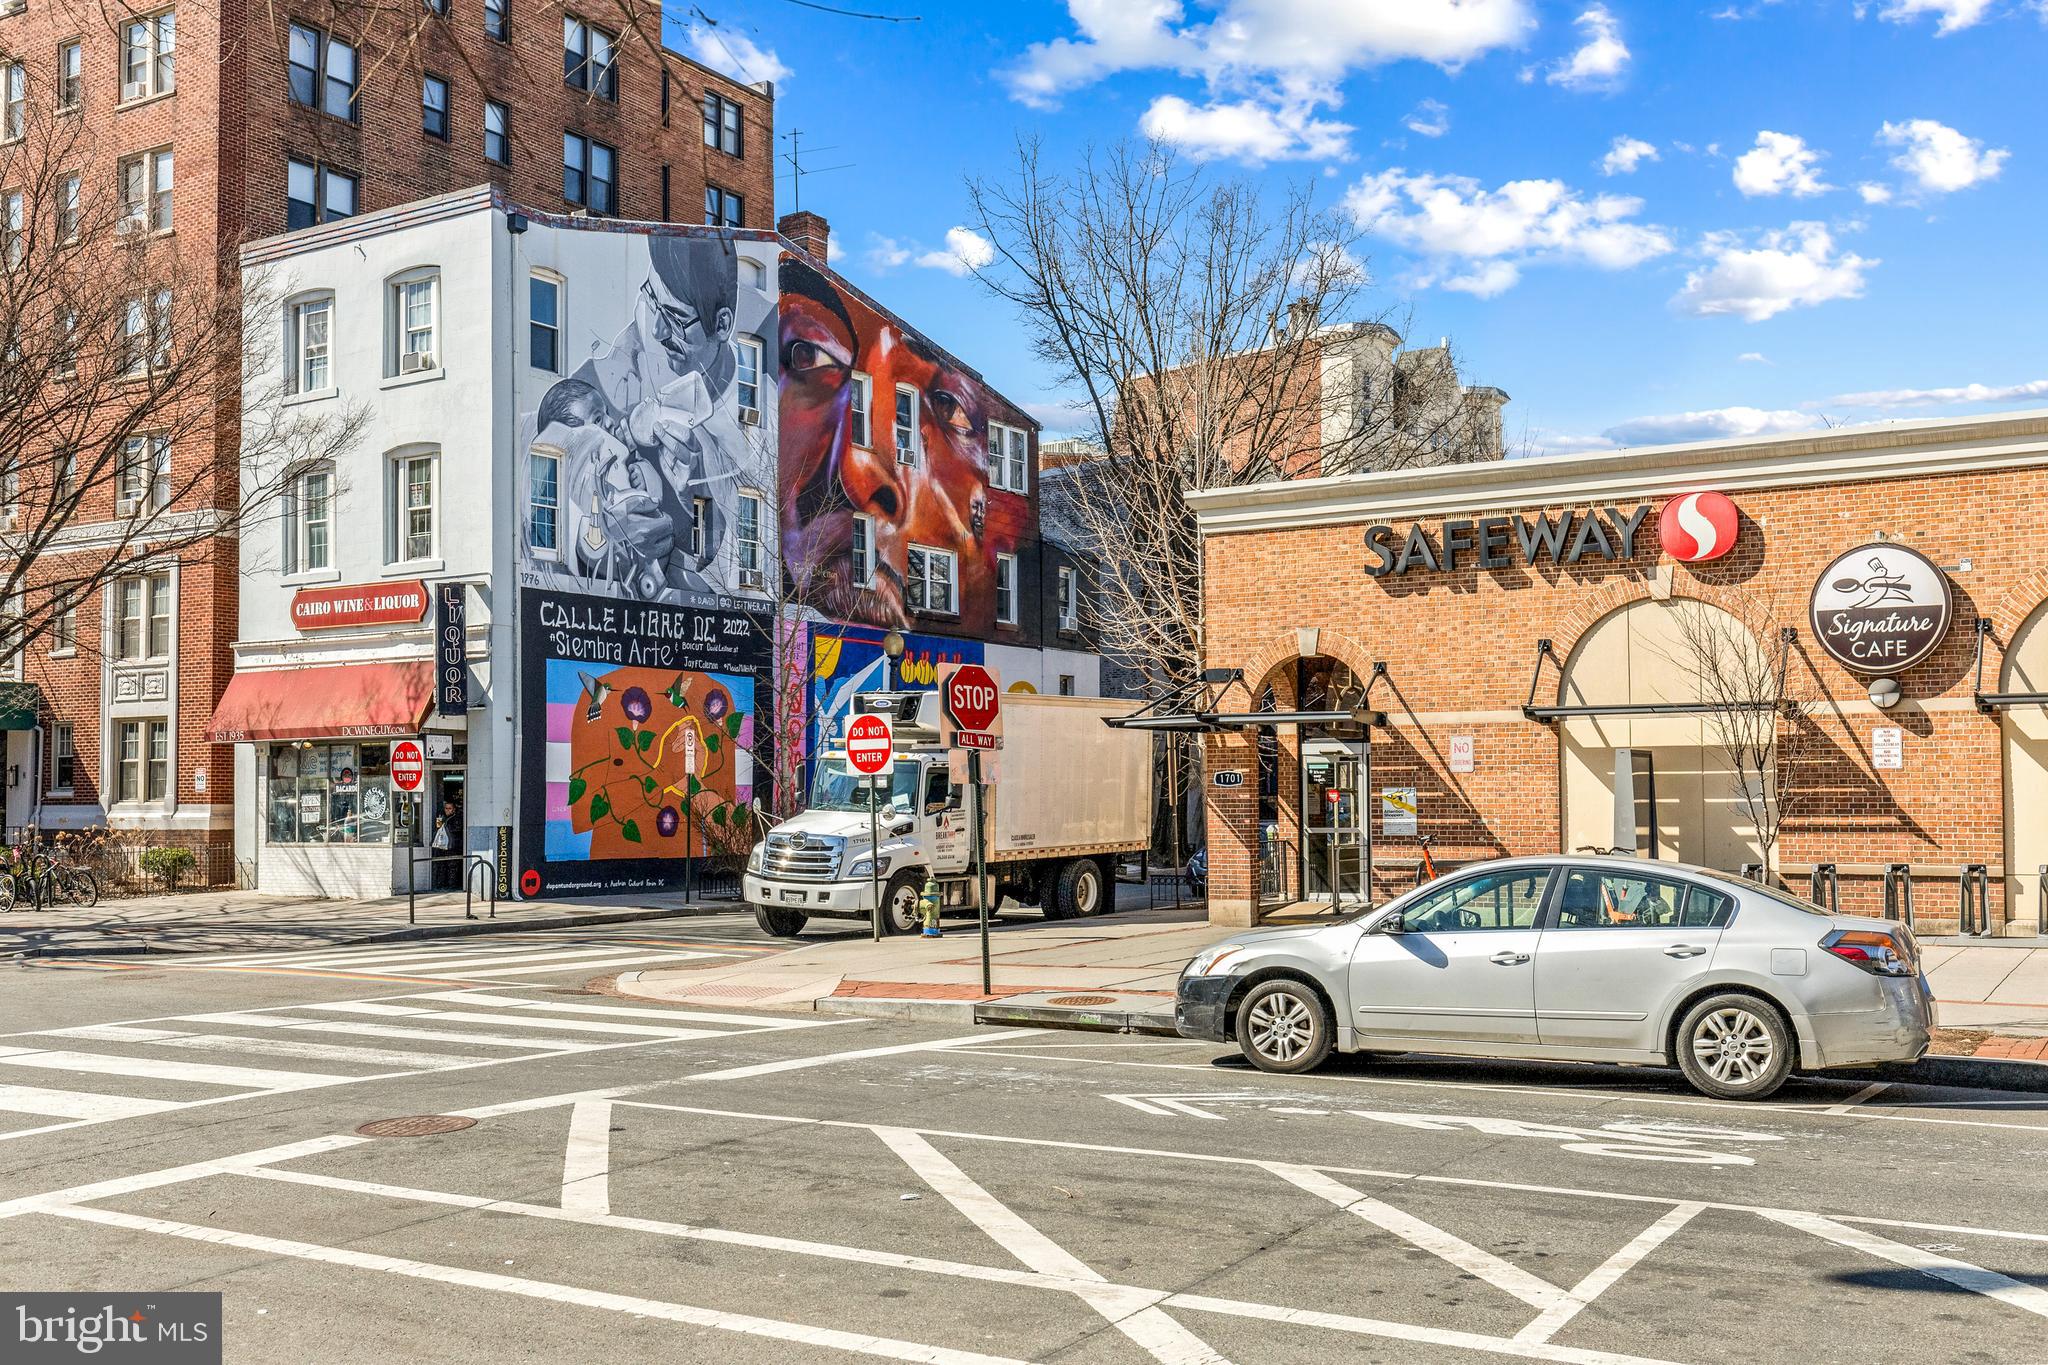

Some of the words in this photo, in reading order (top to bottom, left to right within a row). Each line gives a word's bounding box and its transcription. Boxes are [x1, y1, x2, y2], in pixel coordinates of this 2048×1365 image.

[1364, 505, 1651, 577] SAFEWAY
[520, 572, 540, 586] 1976
[296, 601, 331, 617] CAIRO
[540, 600, 617, 634] CALLE
[623, 608, 685, 640] LIBRE
[693, 615, 716, 643] DC
[722, 617, 751, 637] 2022
[1828, 611, 1934, 642] Signature
[445, 587, 462, 703] LIQUOR
[556, 630, 622, 662] Siembra
[628, 638, 674, 667] Arte
[681, 641, 704, 651] BOICUT
[1851, 639, 1908, 658] CAFE
[954, 684, 995, 711] STOP
[215, 731, 228, 741] EST
[229, 730, 244, 741] 1935
[342, 725, 406, 736] DCWINEGUY.COM
[852, 727, 864, 737] DO
[868, 726, 884, 737] NOT
[961, 735, 975, 746] ALL
[977, 737, 993, 747] WAY
[1453, 742, 1470, 754] NO
[395, 751, 404, 760] DO
[406, 751, 419, 760] NOT
[856, 753, 883, 763] ENTER
[398, 773, 417, 782] ENTER
[1220, 773, 1241, 783] 1701
